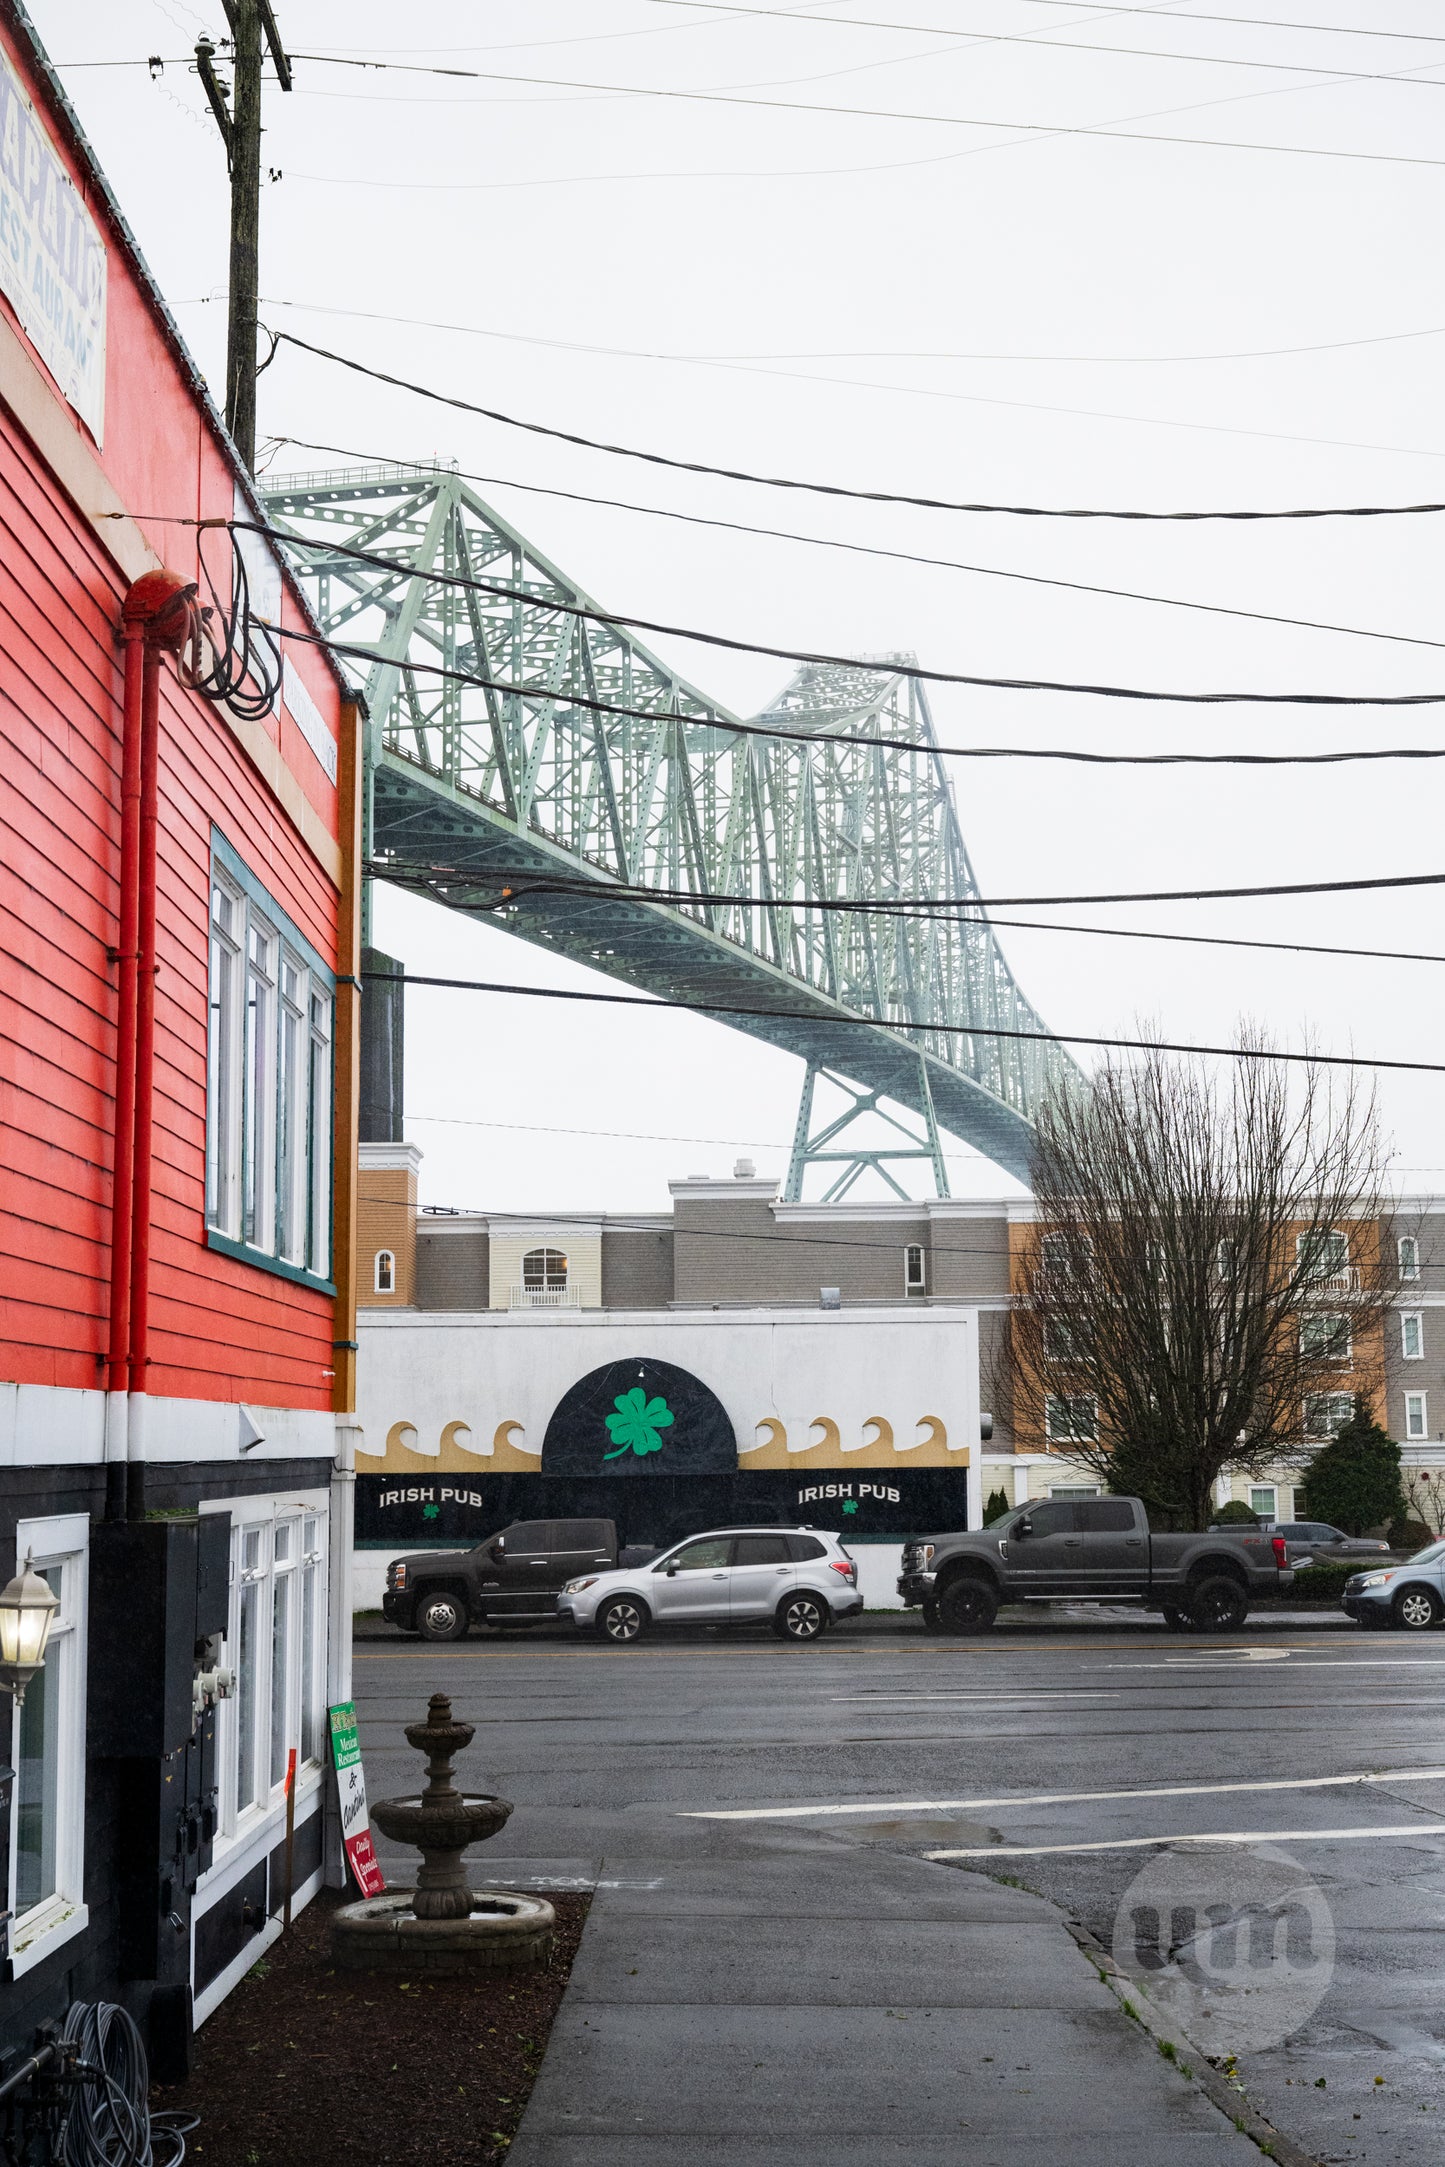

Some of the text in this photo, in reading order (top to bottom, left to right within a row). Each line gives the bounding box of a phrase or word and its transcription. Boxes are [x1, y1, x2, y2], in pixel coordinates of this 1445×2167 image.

[0, 82, 97, 304] APATIO
[379, 1487, 483, 1508] IRISH PUB
[798, 1483, 901, 1505] IRISH PUB
[349, 1772, 358, 1789] &
